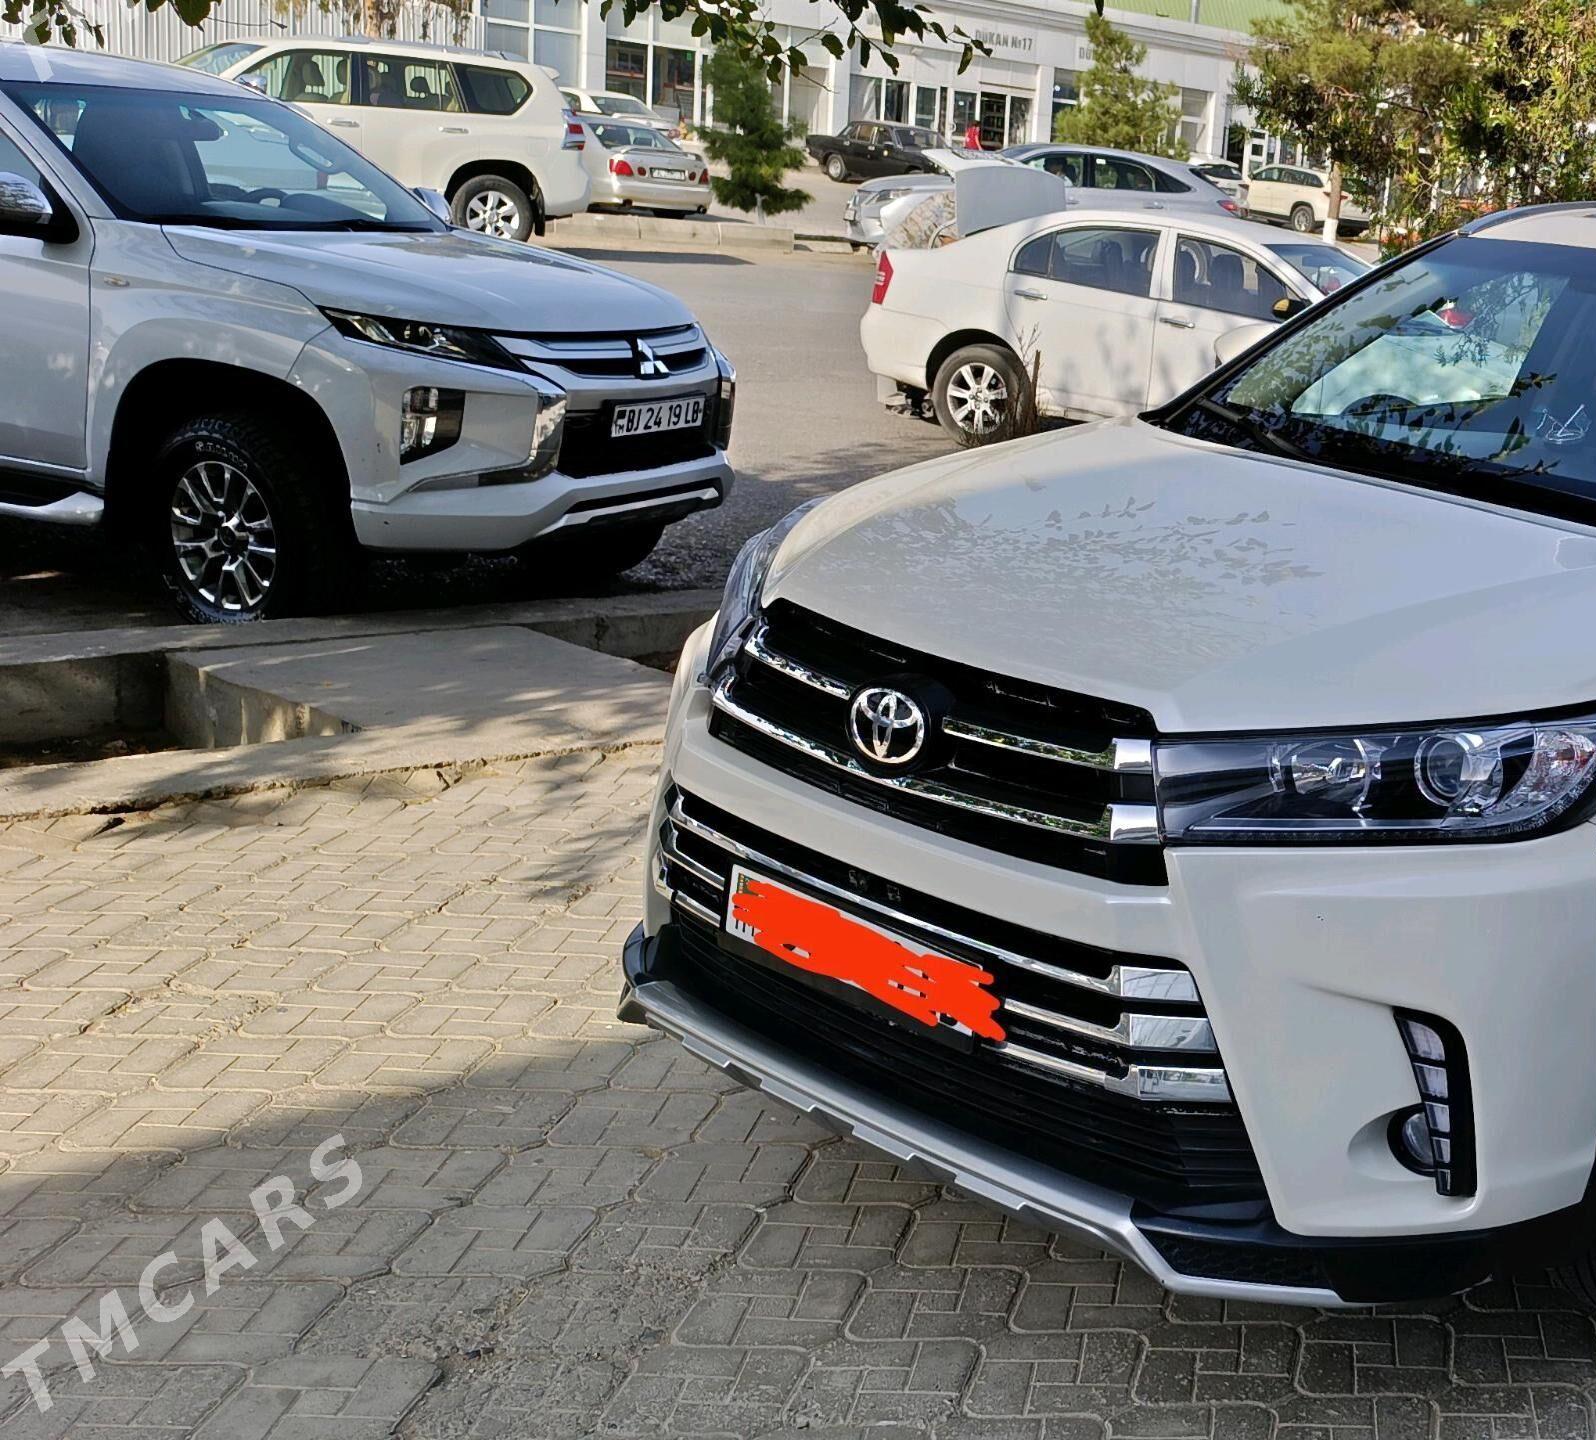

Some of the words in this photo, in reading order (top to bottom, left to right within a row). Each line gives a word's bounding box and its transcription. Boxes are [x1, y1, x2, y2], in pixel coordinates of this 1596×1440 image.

[626, 409, 642, 432] BJ
[643, 407, 663, 430] 24
[667, 404, 682, 427] 19
[684, 401, 700, 424] LB
